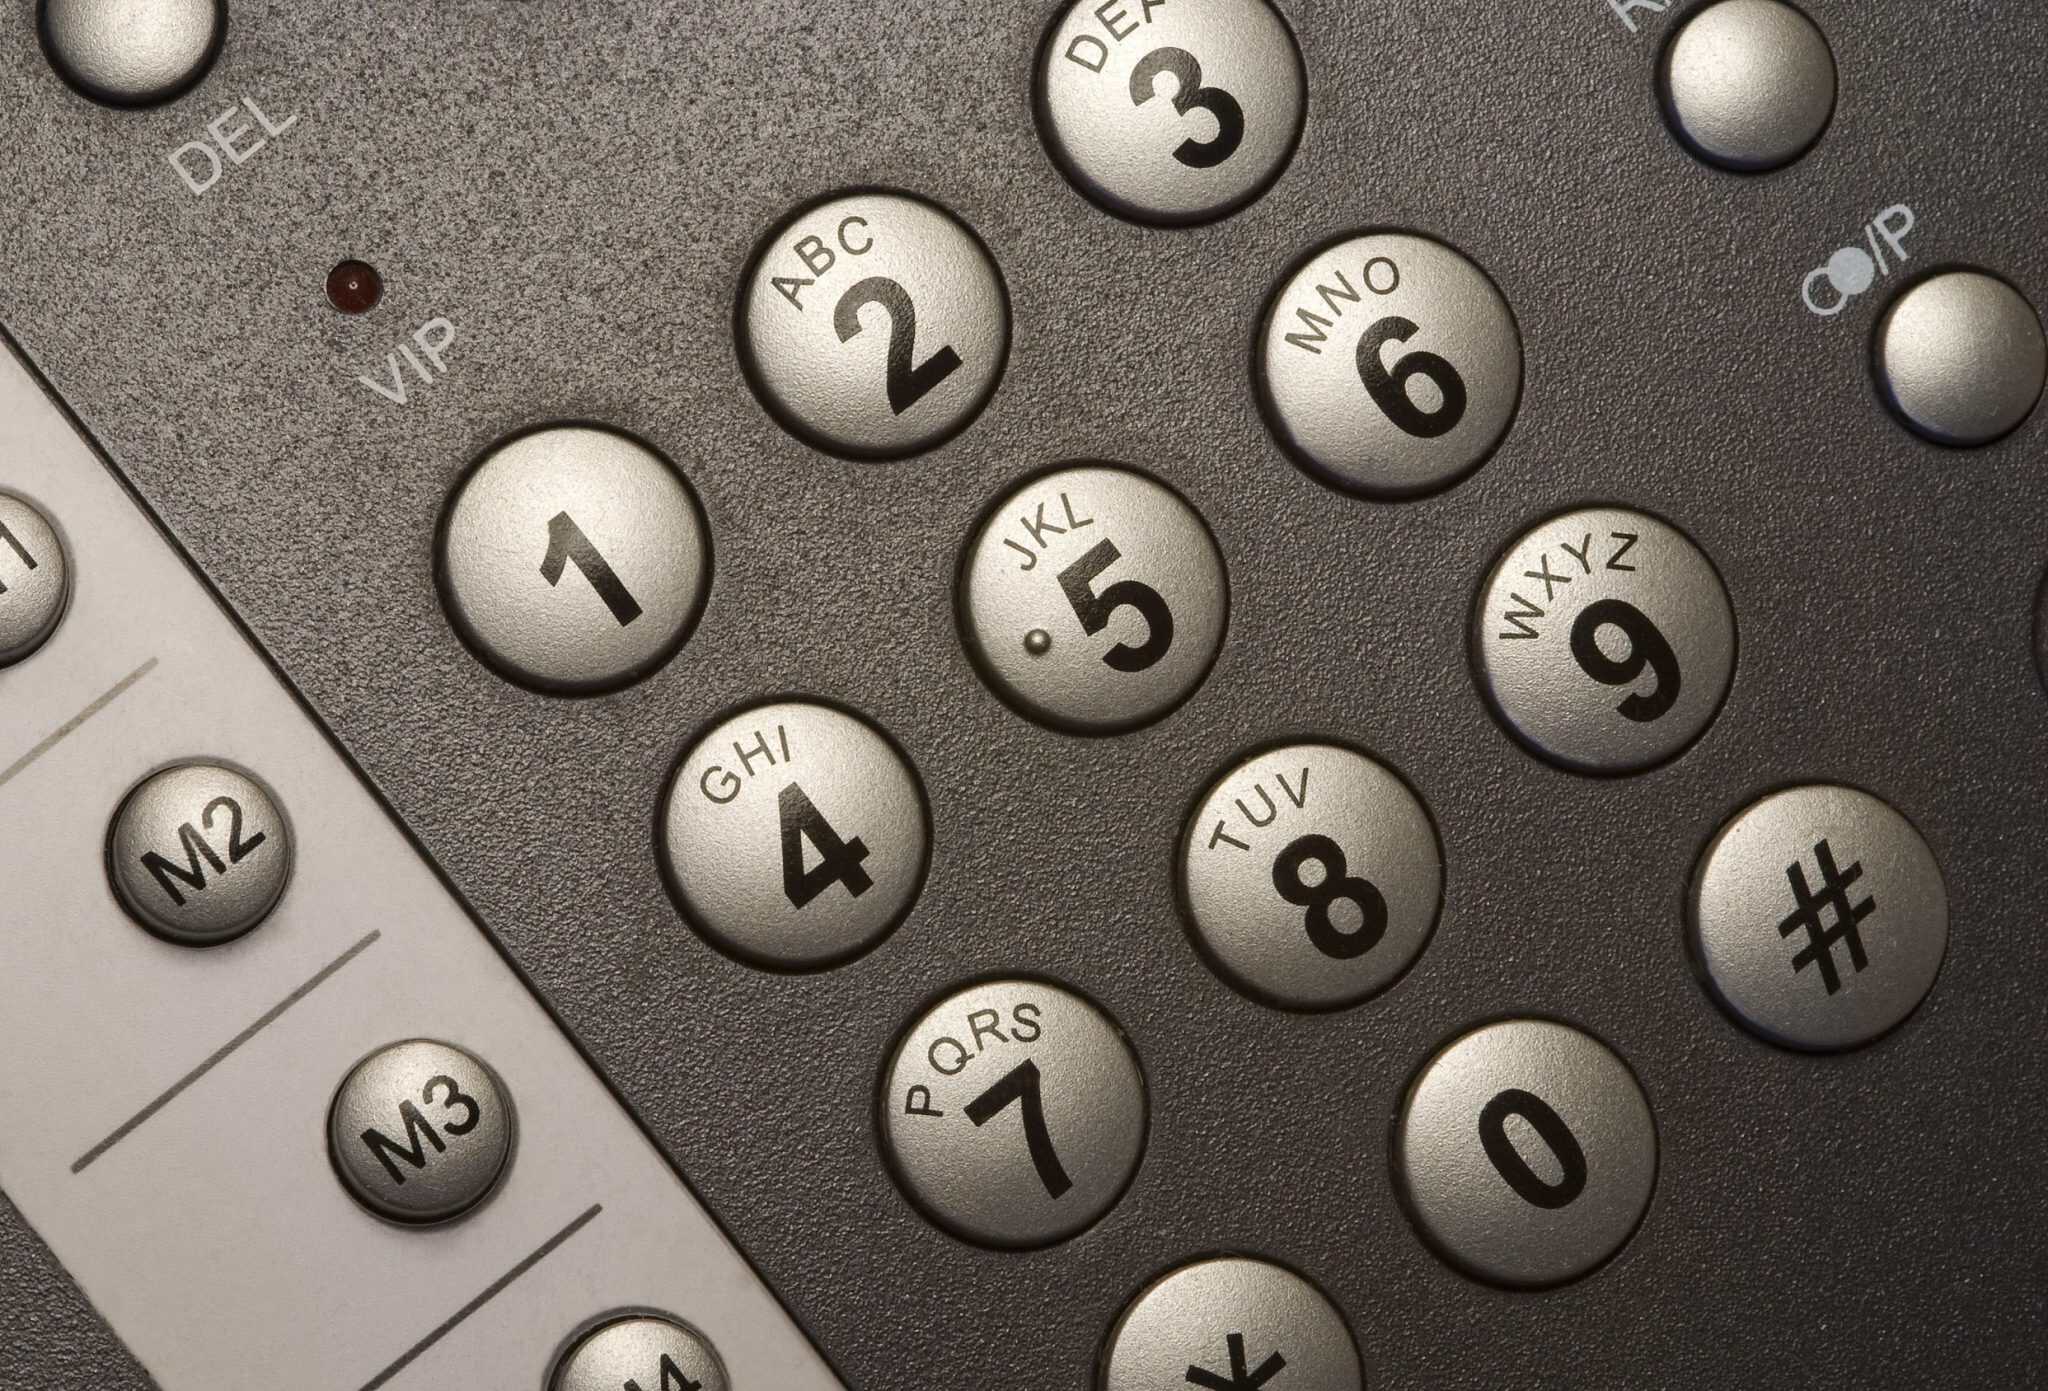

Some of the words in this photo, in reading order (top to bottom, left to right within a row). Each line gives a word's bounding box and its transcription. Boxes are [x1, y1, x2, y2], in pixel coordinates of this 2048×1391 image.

[168, 97, 297, 195] DEL
[1129, 46, 1244, 168] 3
[771, 216, 874, 311] ABC
[1285, 256, 1400, 354] MNO
[358, 317, 455, 405] VIP
[833, 276, 963, 416] 2
[1356, 316, 1467, 438] 6
[539, 510, 643, 627] 1
[1003, 493, 1093, 571] JKL
[1499, 532, 1638, 639] WXYZ
[1056, 537, 1174, 672] 5
[1570, 599, 1681, 722] 9
[700, 725, 791, 804] GHI
[1208, 767, 1309, 856] TUV
[140, 795, 266, 907] M2
[778, 782, 874, 911] 4
[1272, 834, 1388, 960] 8
[1777, 838, 1876, 996] #
[905, 1003, 1041, 1117] PQRS
[360, 1075, 480, 1186] M3
[963, 1058, 1073, 1200] 7
[1478, 1088, 1587, 1209] 0
